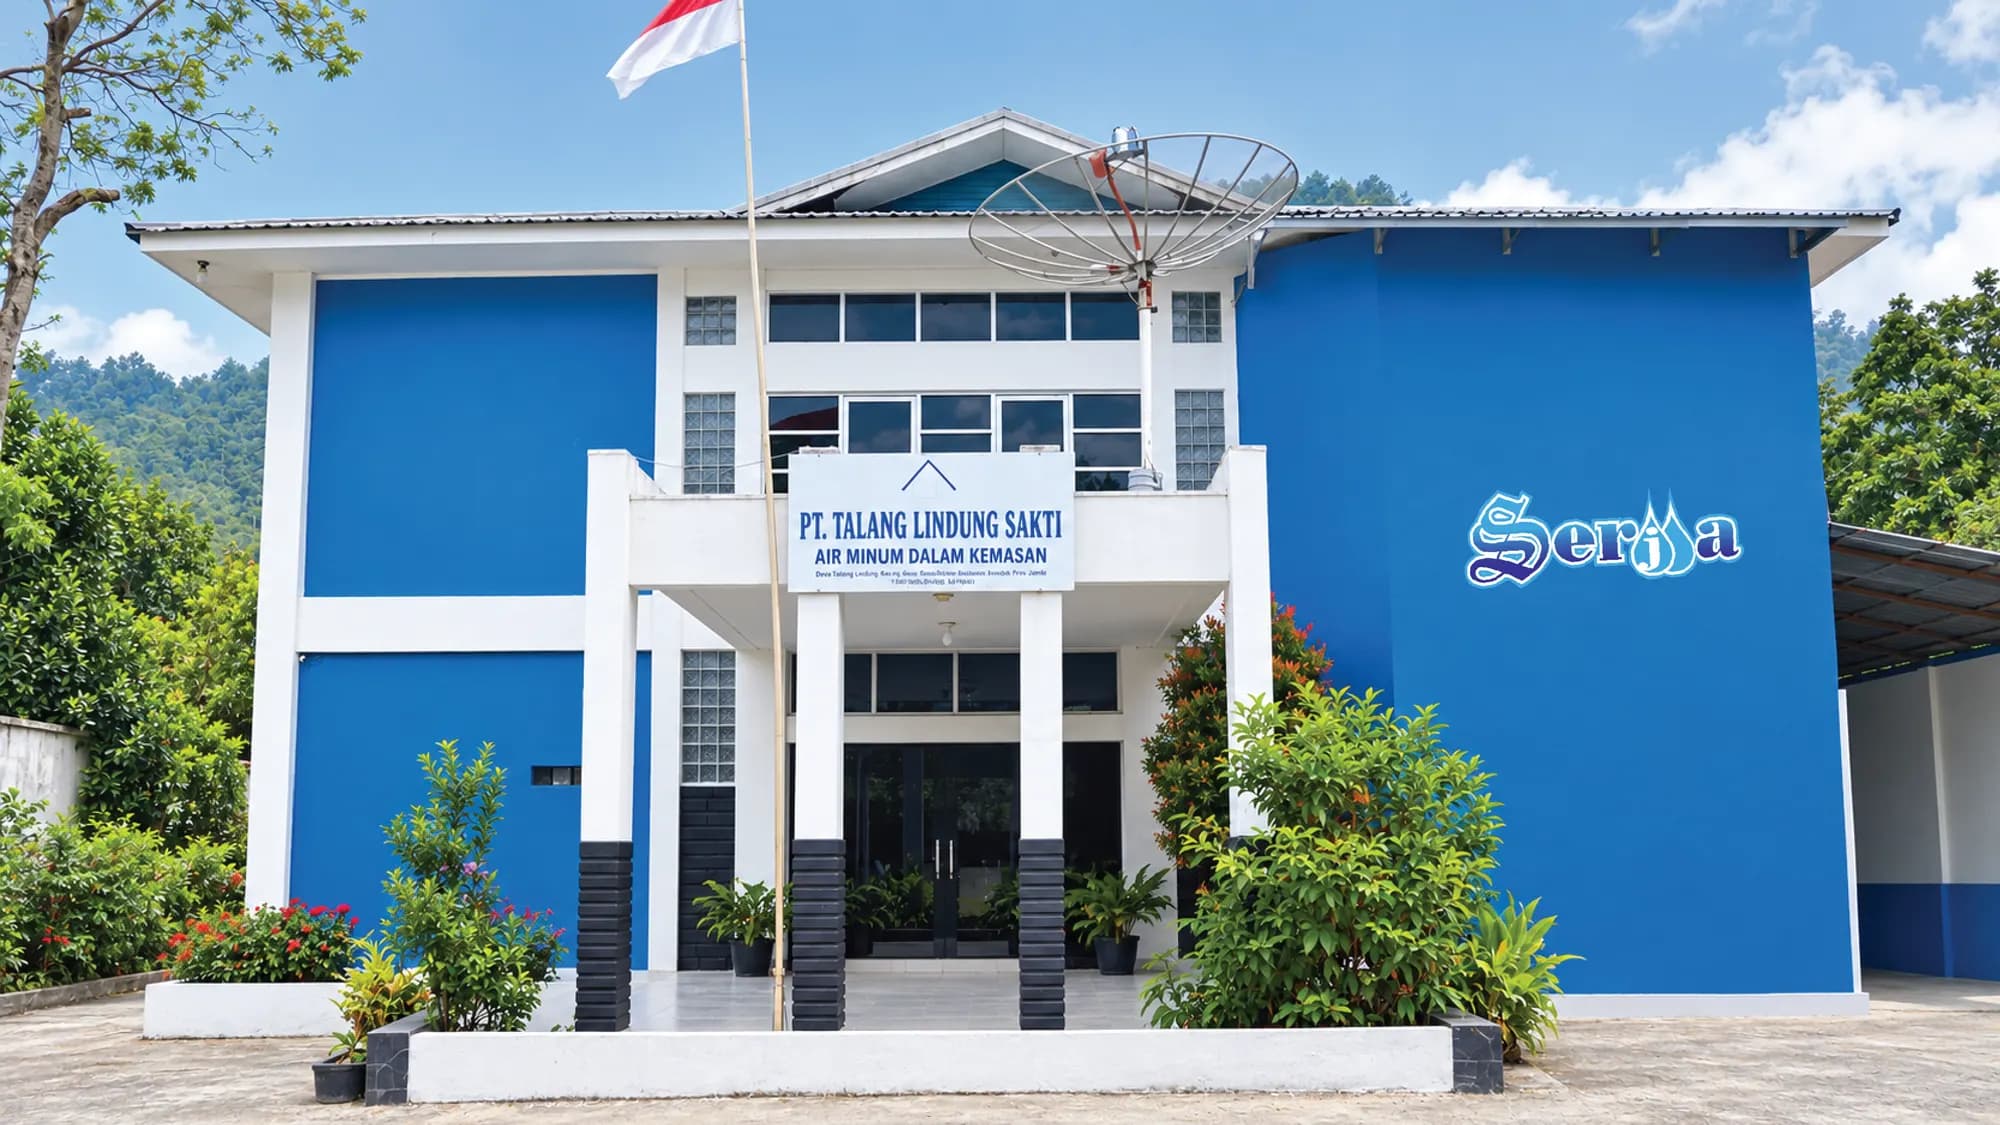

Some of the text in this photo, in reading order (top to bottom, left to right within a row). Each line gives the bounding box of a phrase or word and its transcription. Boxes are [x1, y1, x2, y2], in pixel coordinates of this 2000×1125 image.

[799, 510, 1063, 540] PT. TALANG LINDUNG SAKTI
[815, 547, 1047, 565] AIR MINUM DALAM KEMASAN
